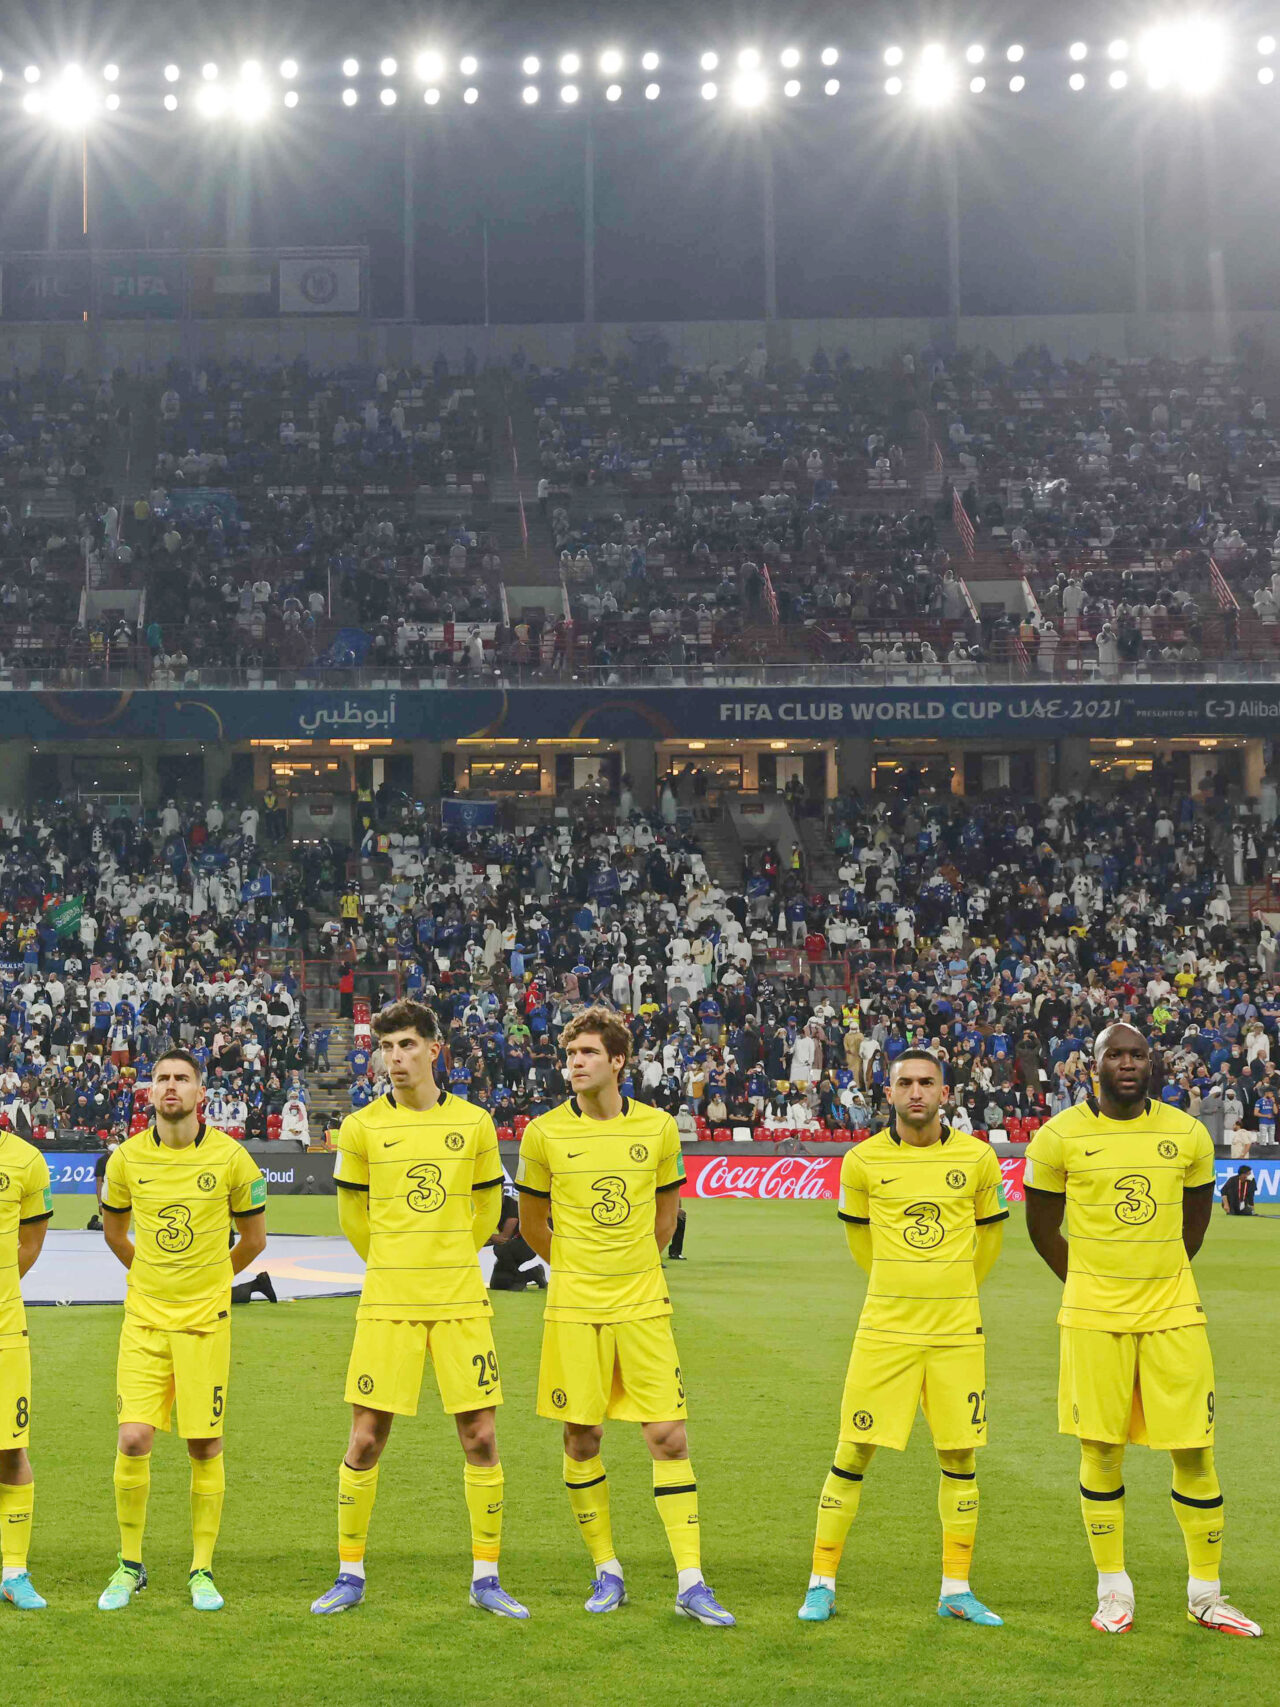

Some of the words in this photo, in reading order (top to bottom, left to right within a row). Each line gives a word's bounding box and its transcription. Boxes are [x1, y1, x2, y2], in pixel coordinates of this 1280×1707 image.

[112, 275, 169, 296] FIFA
[299, 693, 396, 735] أبوظبي
[720, 703, 773, 721] FIFA
[778, 703, 844, 720] CLUB
[850, 702, 945, 720] WORLD
[951, 702, 1002, 719] CUP
[1008, 698, 1068, 719] UAE
[1070, 700, 1120, 719] 2021
[1136, 710, 1185, 718] PRESENTED
[60, 1165, 96, 1183] 202
[406, 1163, 446, 1213] 3
[591, 1175, 630, 1226] 3
[1114, 1174, 1157, 1225] 3
[156, 1204, 194, 1253] 3
[903, 1202, 945, 1249] 3
[472, 1350, 499, 1387] 29
[16, 1396, 29, 1428] 8
[212, 1386, 223, 1417] 5
[1207, 1391, 1215, 1424] 9
[577, 1511, 597, 1519] CFC
[822, 1496, 842, 1506] CFC
